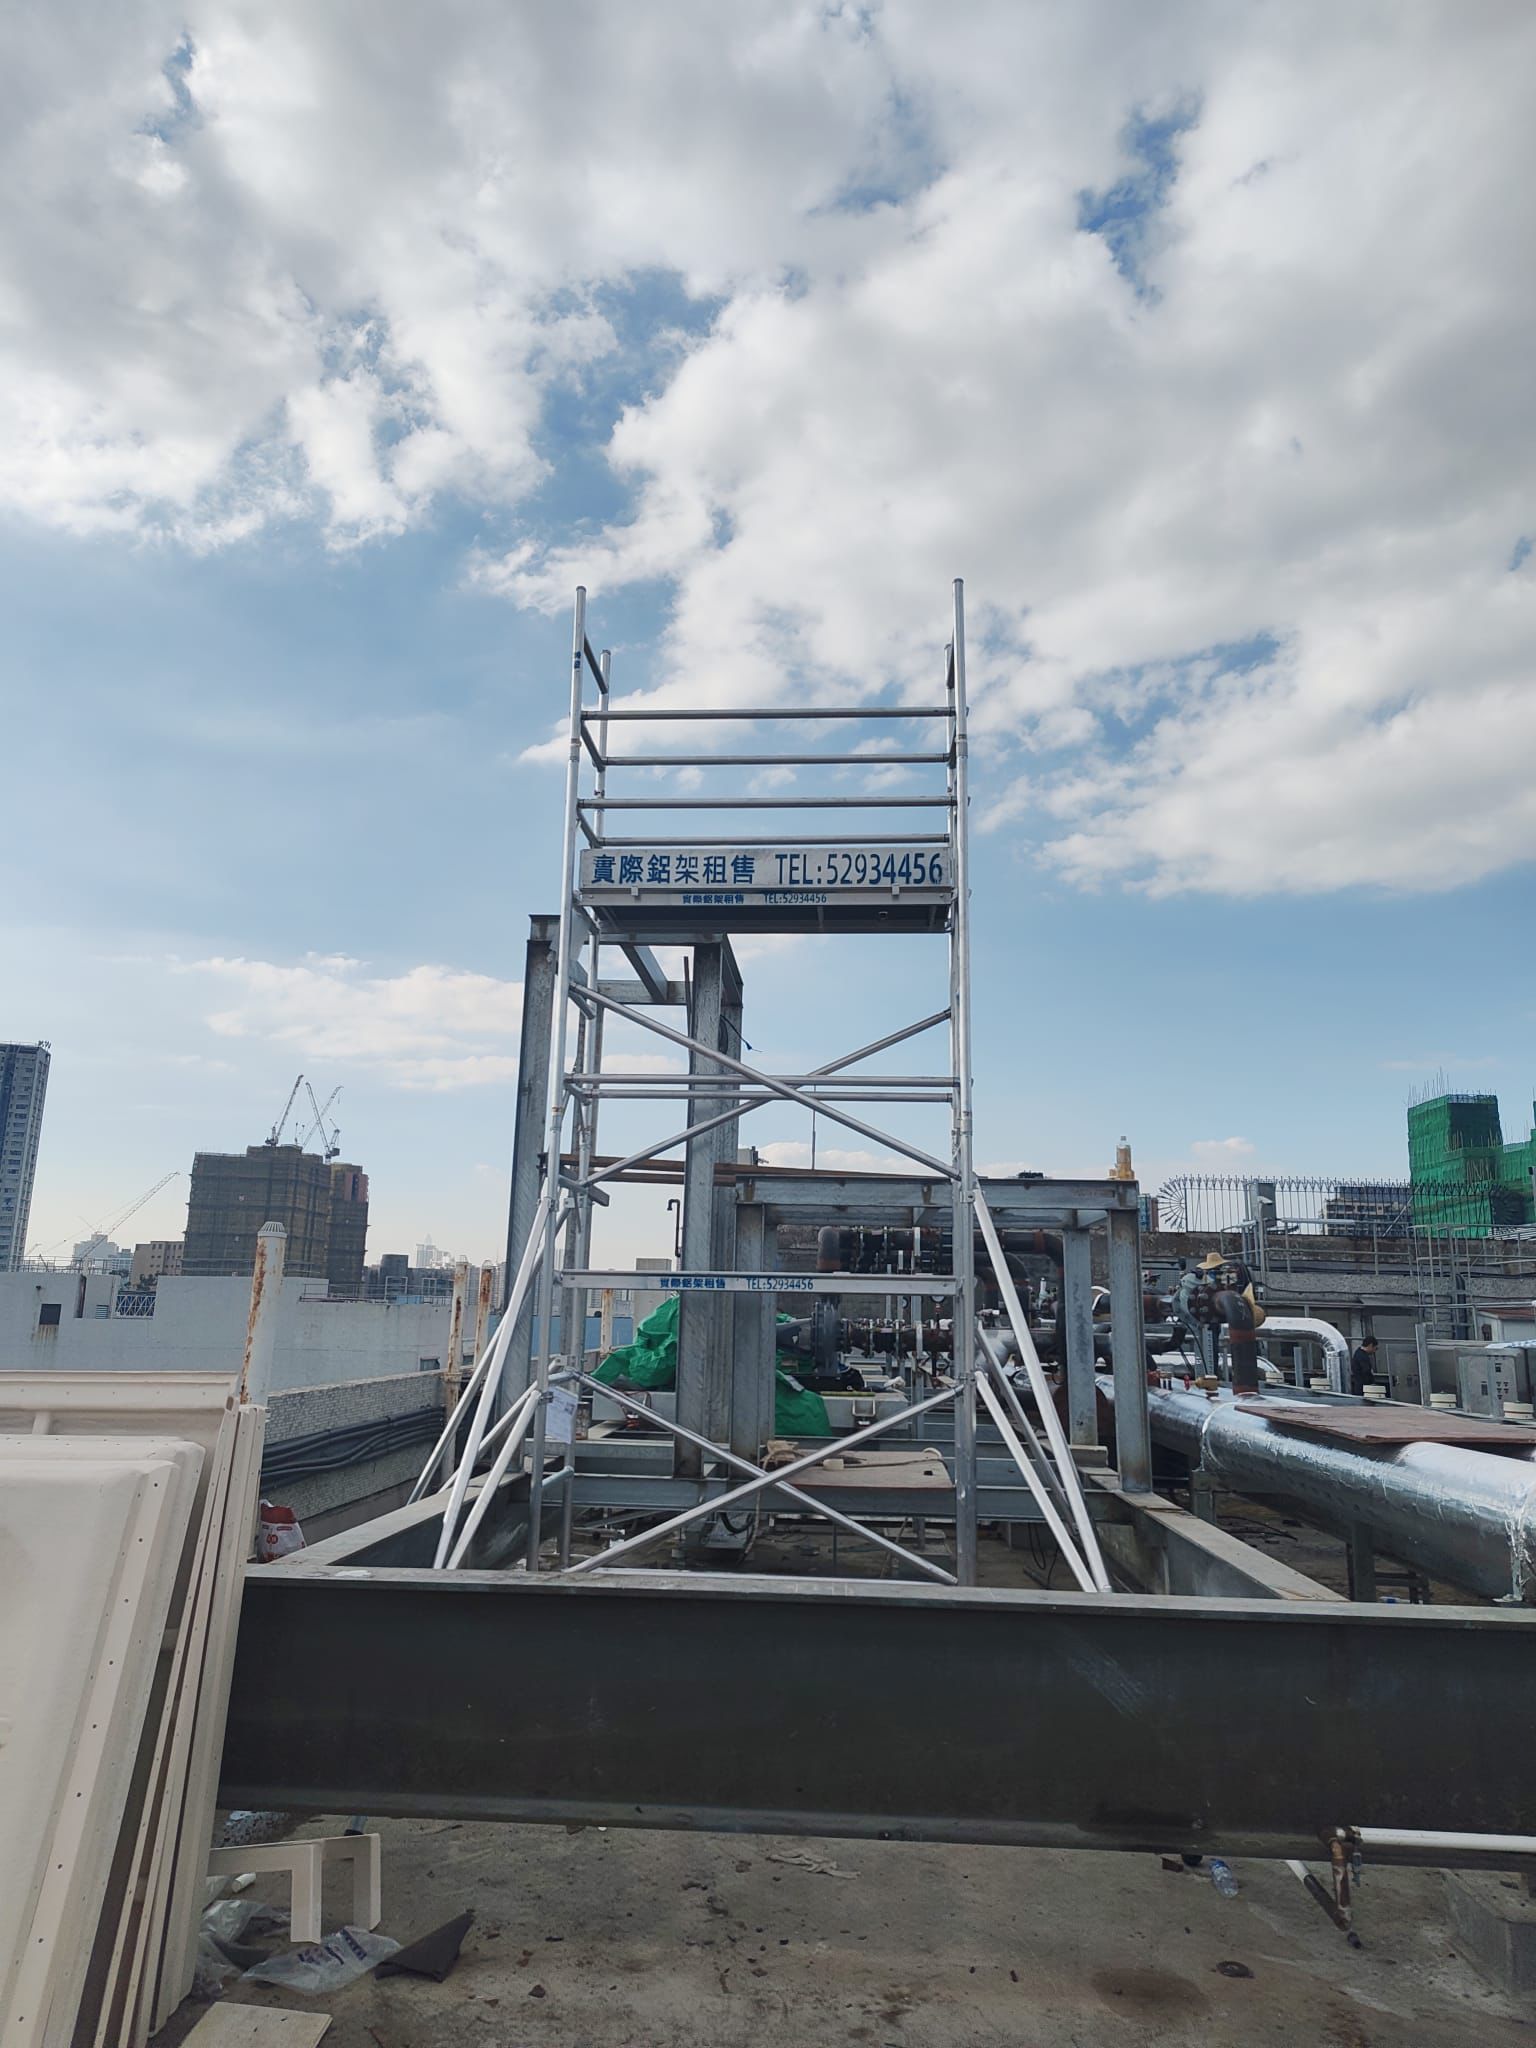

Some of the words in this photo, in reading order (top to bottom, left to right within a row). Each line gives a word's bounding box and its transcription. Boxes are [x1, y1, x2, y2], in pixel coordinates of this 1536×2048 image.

[591, 854, 755, 884] 實際鋁架租售
[775, 853, 943, 885] TEL:52934456
[763, 893, 827, 904] TEL:52934456
[746, 1278, 814, 1290] TEL:52934456
